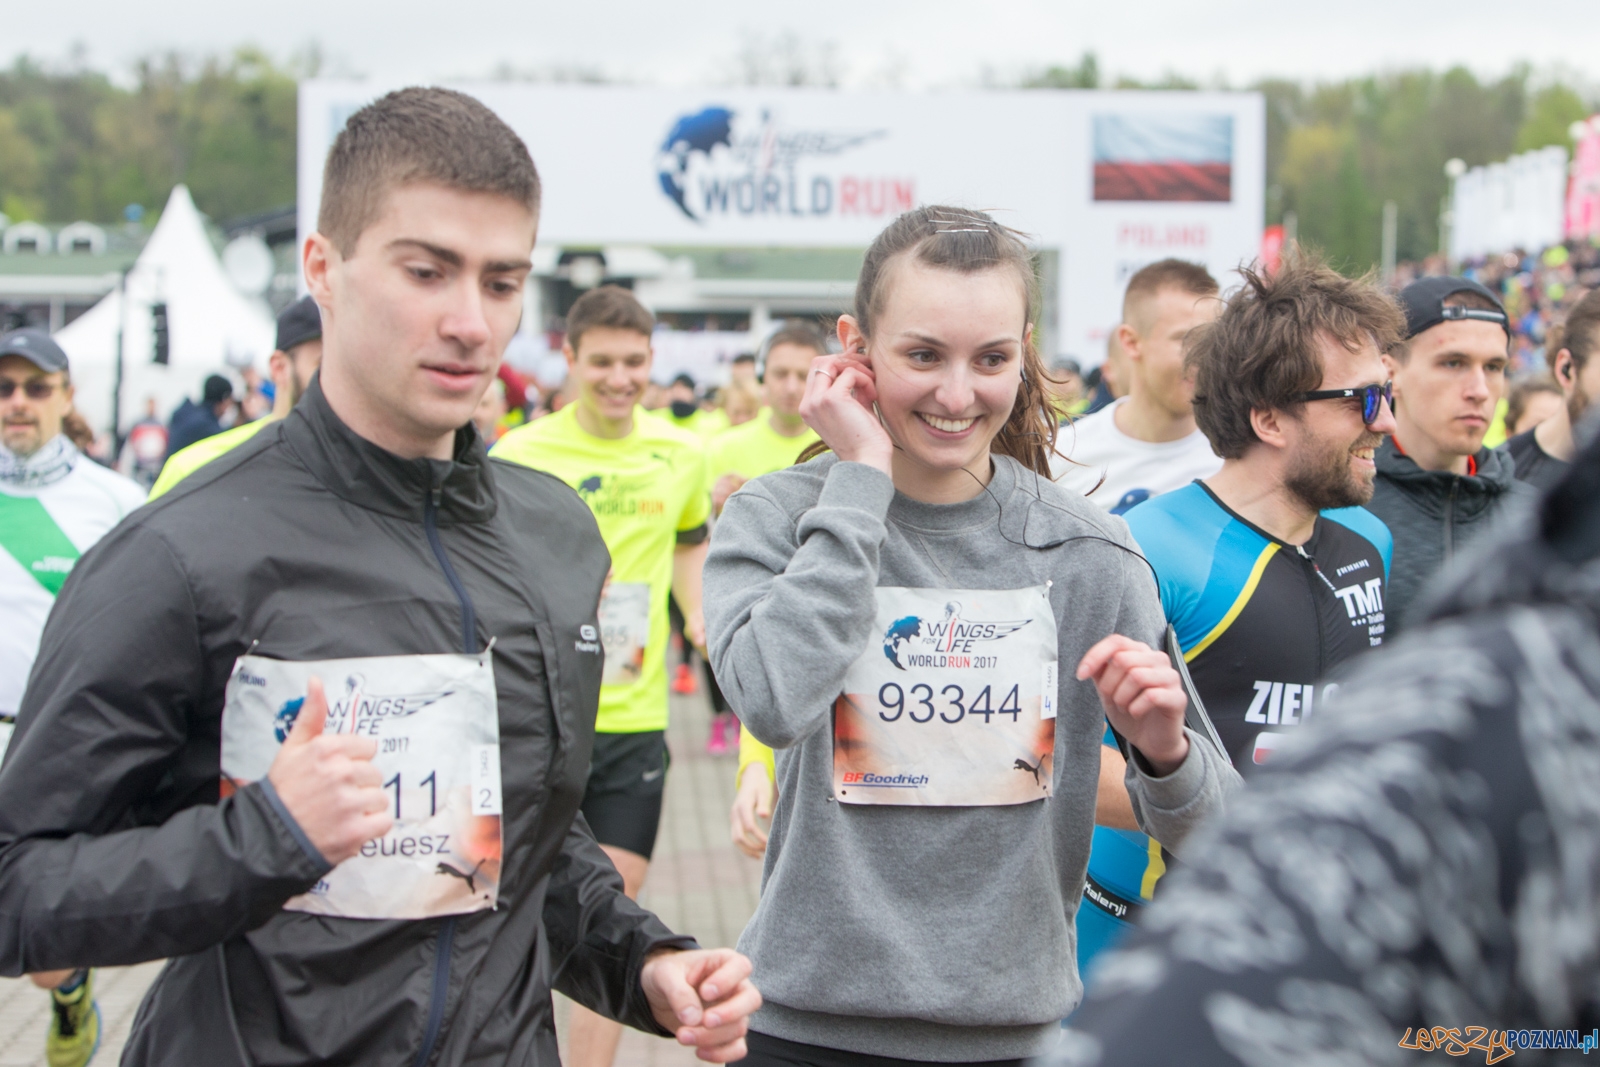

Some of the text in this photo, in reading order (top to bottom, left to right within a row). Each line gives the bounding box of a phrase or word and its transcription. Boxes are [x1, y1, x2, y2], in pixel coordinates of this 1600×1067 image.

[1334, 577, 1383, 618] TMT
[926, 618, 996, 638] WINGS
[922, 637, 976, 653] FOR LIFE
[973, 656, 998, 669] 2017
[326, 696, 406, 718] WINGS
[878, 682, 1022, 724] 93344
[1045, 695, 1052, 712] 4
[324, 720, 338, 729] OR
[382, 737, 409, 753] 2017
[843, 772, 929, 784] BFGoodrich
[383, 770, 437, 820] 11
[479, 788, 492, 809] 2
[360, 835, 451, 858] euesz
[1084, 880, 1127, 917] Kalenji
